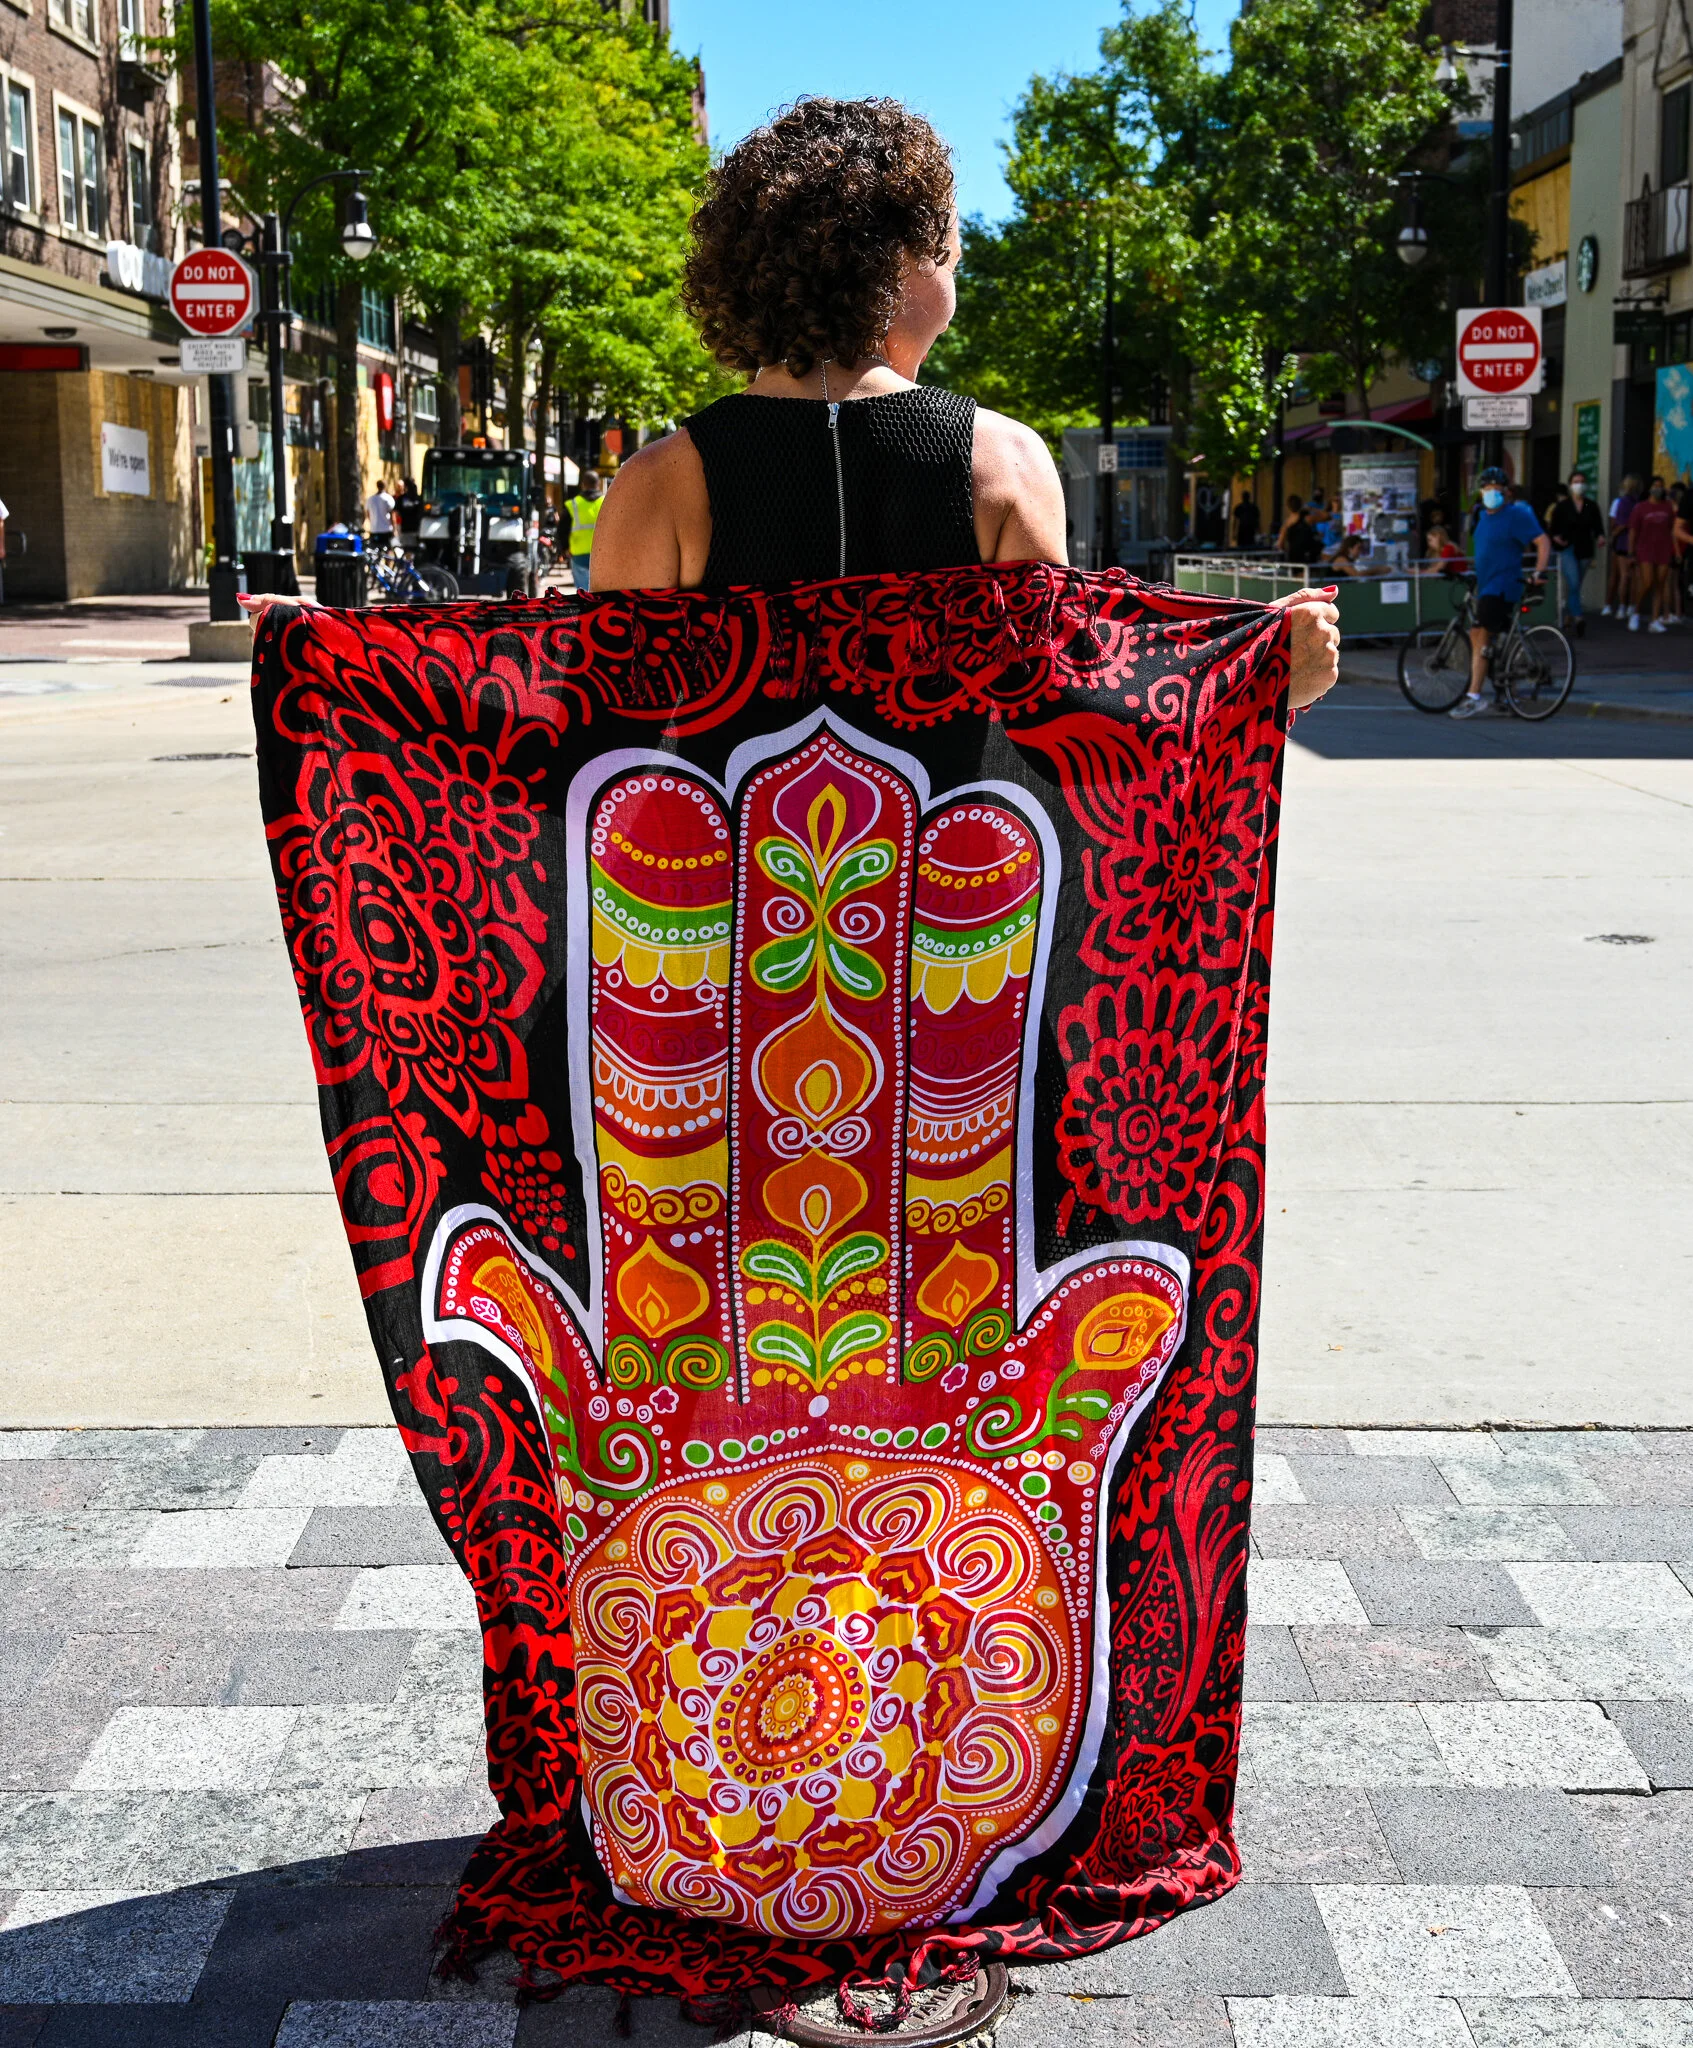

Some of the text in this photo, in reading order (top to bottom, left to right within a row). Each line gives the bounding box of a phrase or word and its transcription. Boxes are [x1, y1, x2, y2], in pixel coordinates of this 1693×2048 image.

[184, 266, 236, 280] DO NOT
[186, 304, 236, 318] ENTER
[1472, 325, 1526, 340] DO NOT
[1473, 363, 1525, 378] ENTER
[108, 447, 146, 475] We're open
[1102, 457, 1115, 470] 15
